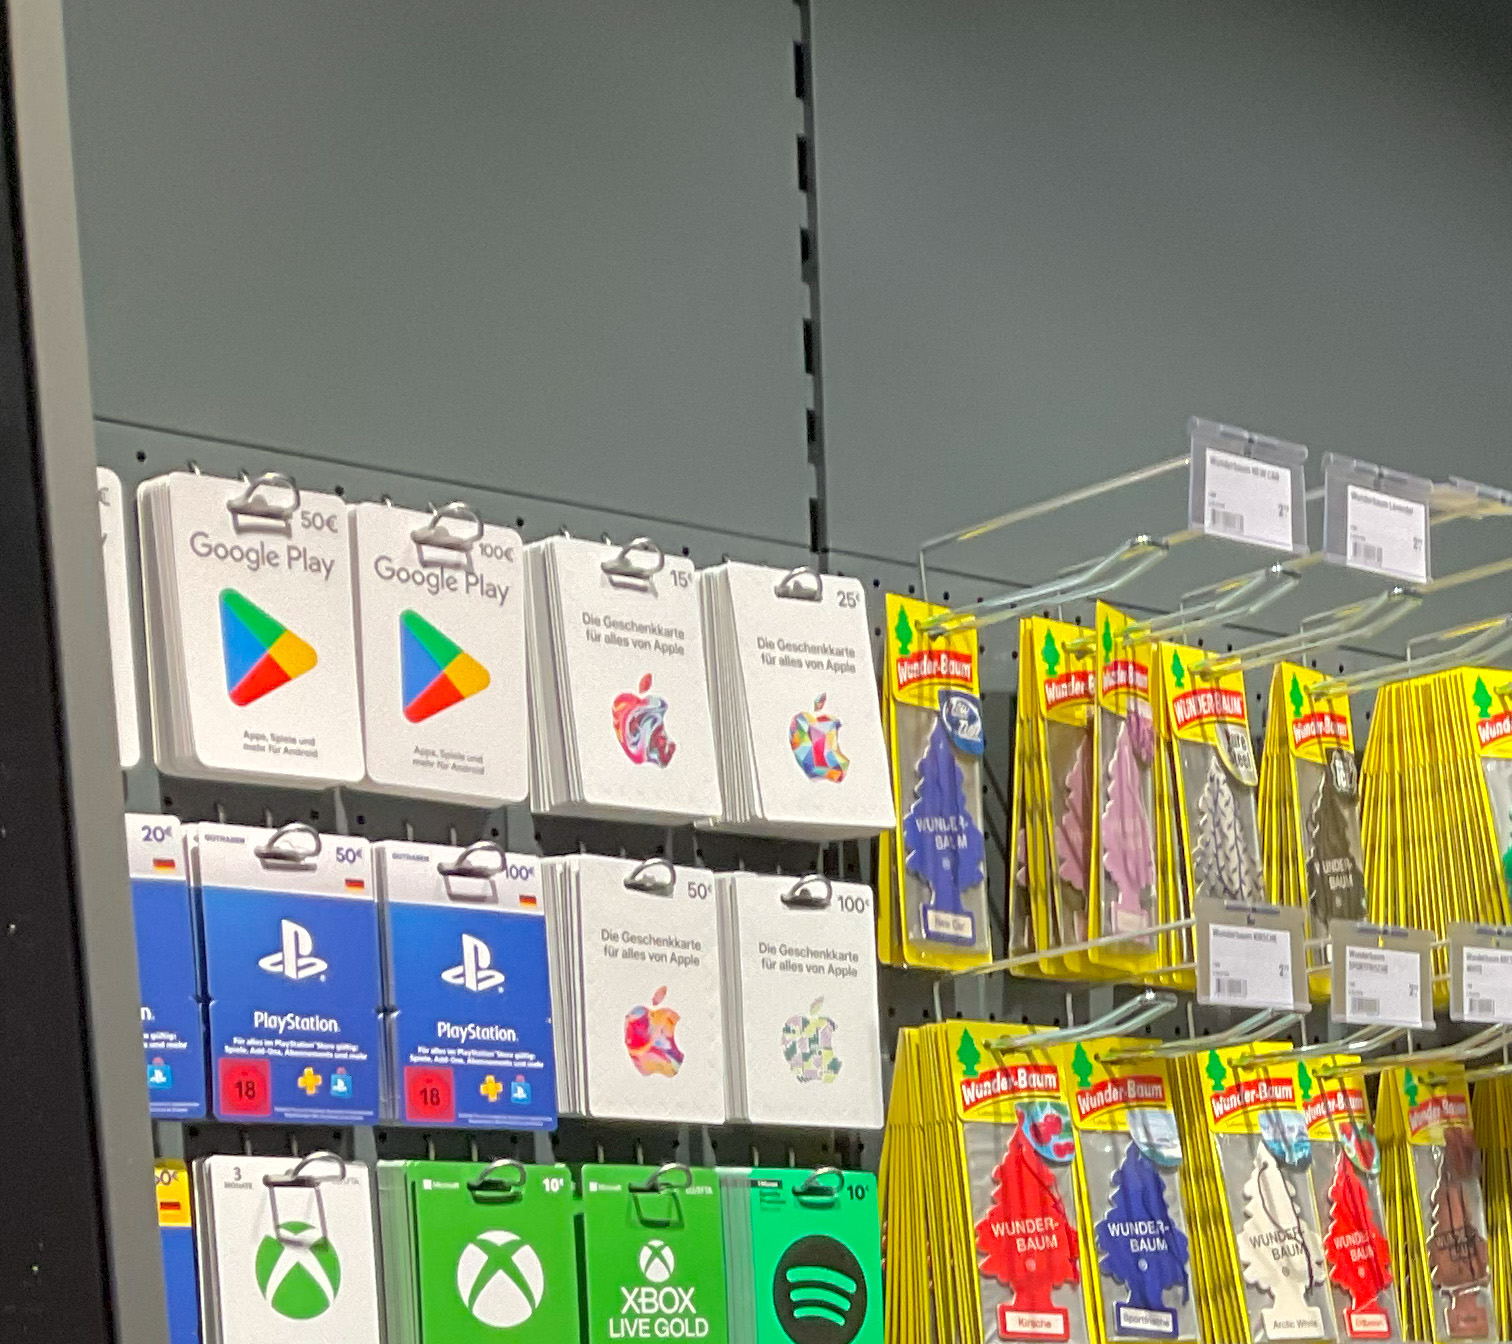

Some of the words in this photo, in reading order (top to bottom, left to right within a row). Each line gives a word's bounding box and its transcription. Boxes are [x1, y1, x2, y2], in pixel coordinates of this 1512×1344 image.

[300, 510, 339, 534] 50€
[189, 530, 280, 572] Google
[286, 546, 336, 583] Play
[374, 554, 459, 596] Google
[464, 571, 510, 607] Play
[582, 611, 601, 628] Die
[603, 614, 686, 641] Geschenkkarte
[586, 629, 602, 644] für
[604, 632, 630, 649] alles
[632, 636, 651, 650] von
[653, 639, 686, 657] Apple
[757, 636, 775, 652] Die
[777, 638, 857, 660] Geschenkkarte
[896, 651, 973, 685] Wunder-Baum
[1173, 691, 1244, 724] WUNDER-BAUM
[253, 1009, 341, 1035] PlayStation
[436, 1020, 519, 1044] PlayStation
[234, 1079, 257, 1101] 18
[419, 1087, 442, 1107] 18
[961, 1070, 1058, 1105] Wunder-Baum
[1077, 1080, 1164, 1115] Wunder-Baum
[1211, 1080, 1293, 1119] Wunder-Baum
[232, 1166, 243, 1182] 3
[991, 1217, 1060, 1237] WUNDER-
[1016, 1234, 1059, 1254] BAUM
[1129, 1236, 1169, 1252] BAUM
[620, 1285, 697, 1315] XBOX
[608, 1317, 651, 1339] LIVE
[653, 1316, 709, 1339] GOLD
[1017, 1316, 1053, 1330] Kirsche
